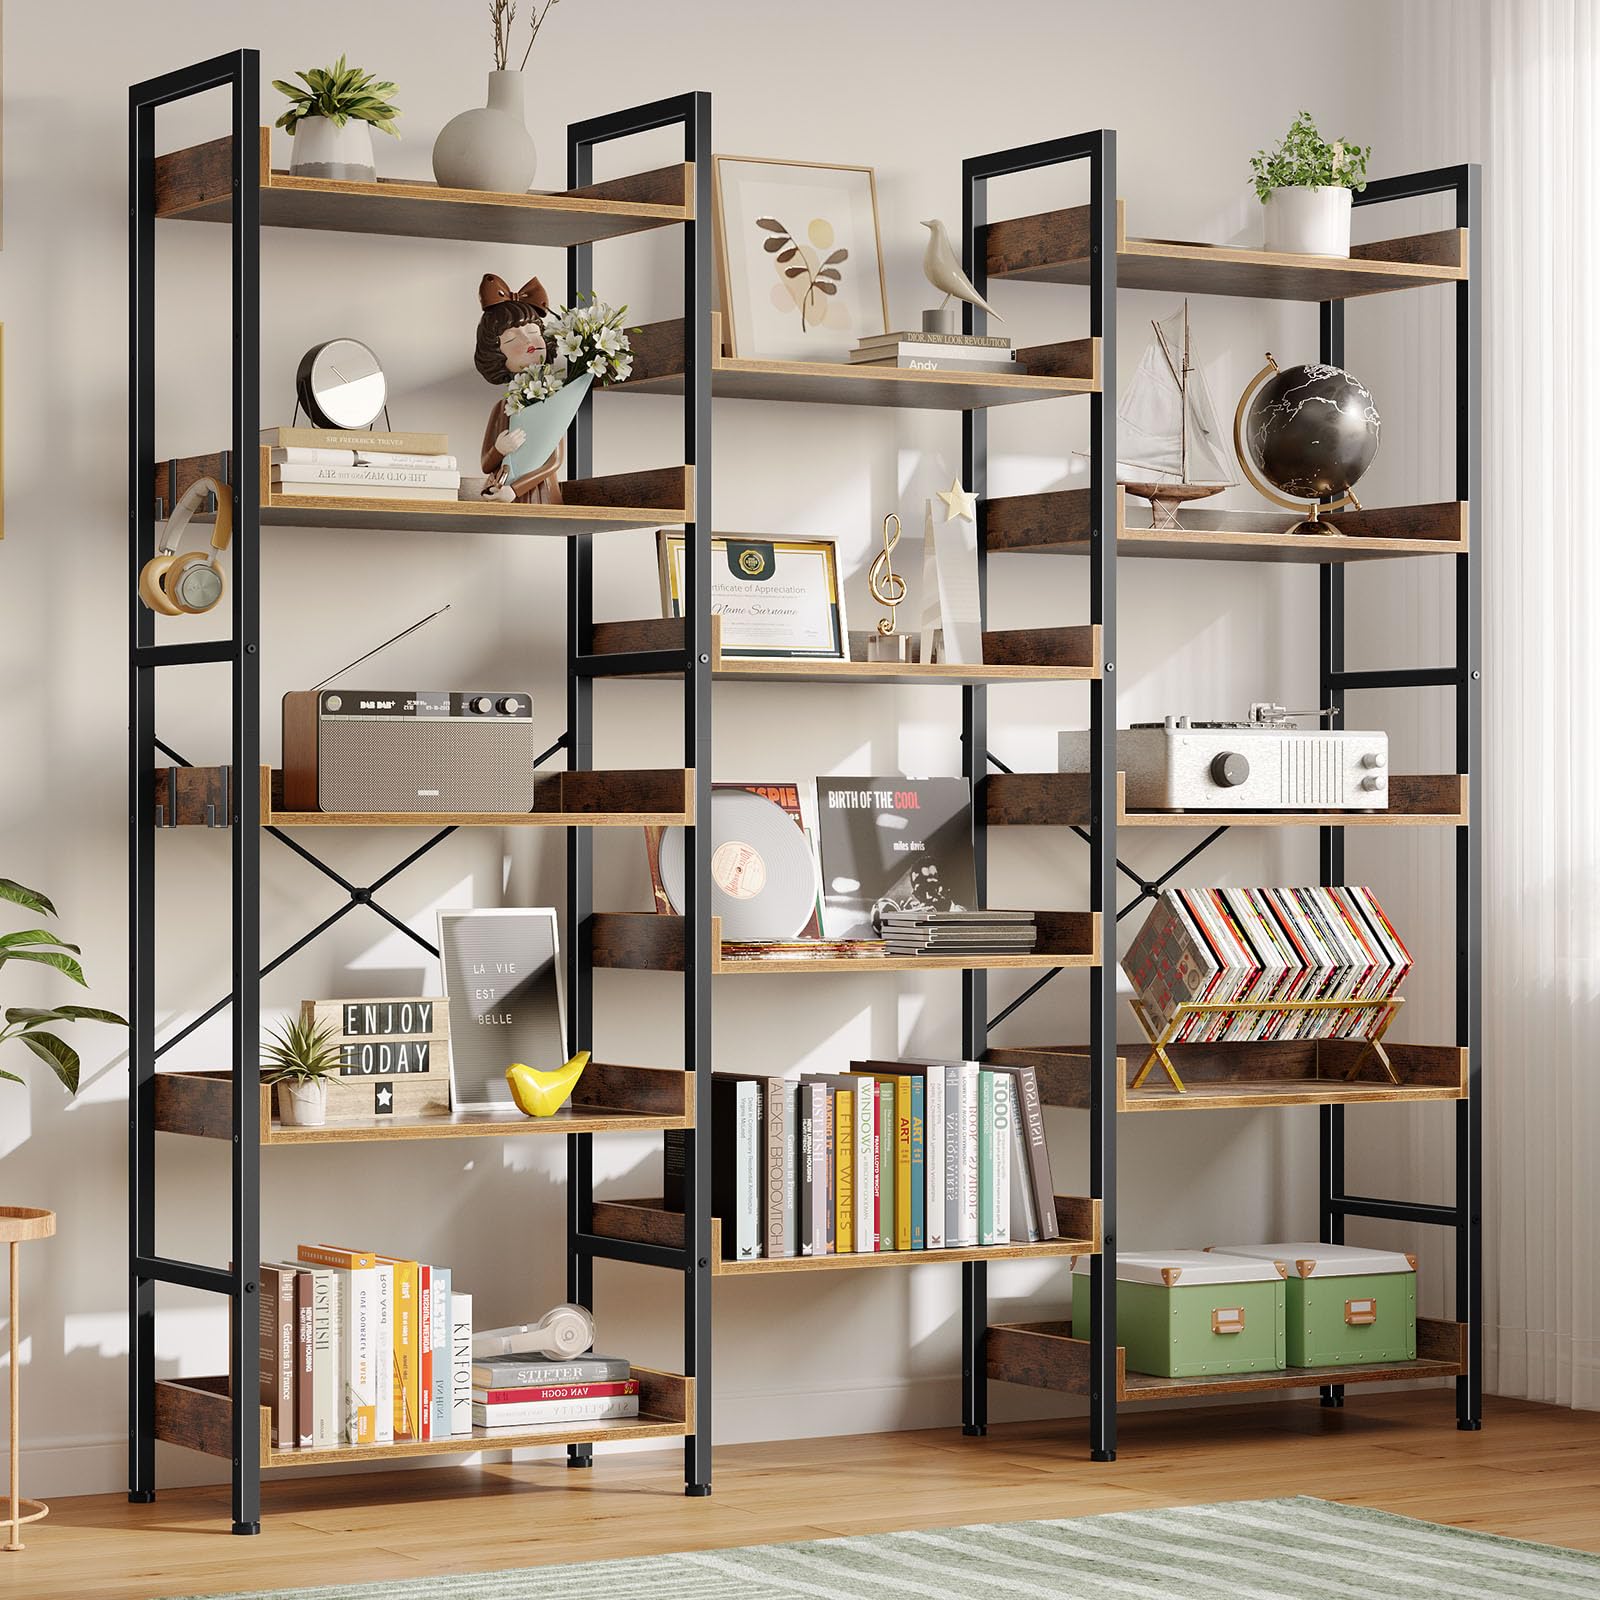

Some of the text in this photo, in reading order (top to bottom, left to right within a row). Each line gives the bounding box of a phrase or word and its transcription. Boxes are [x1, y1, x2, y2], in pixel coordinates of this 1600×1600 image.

[927, 334, 943, 343] NEW
[944, 336, 964, 345] LOOK
[964, 338, 1008, 348] REVOLUTION
[909, 359, 938, 371] Andy
[745, 584, 753, 593] of
[755, 584, 806, 595] Appreciation
[711, 603, 798, 616] Name Surname
[360, 701, 375, 709] DAB
[828, 790, 921, 810] BIRTH OF THE COOL
[893, 840, 925, 851] miles davis
[473, 963, 516, 974] LA VIE
[475, 989, 495, 1000] EST
[347, 1003, 432, 1035] ENJOY
[478, 1013, 513, 1025] BELLE
[343, 1044, 428, 1075] TODAY
[770, 1083, 783, 1142] ALEXEY
[813, 1088, 824, 1161] LOST FISH
[861, 1083, 872, 1154] WINDOWS
[900, 1118, 910, 1144] ART
[913, 1116, 923, 1145] ART
[840, 1114, 851, 1230] FINE WINES
[770, 1146, 784, 1246] BRODOVITCH
[315, 1275, 329, 1350] LOST FISH
[305, 1307, 313, 1373] NEW URBAN HOUSING
[283, 1323, 293, 1400] Gardens in France
[454, 1322, 470, 1409] KINFOLK
[517, 1367, 583, 1381] STIFTER
